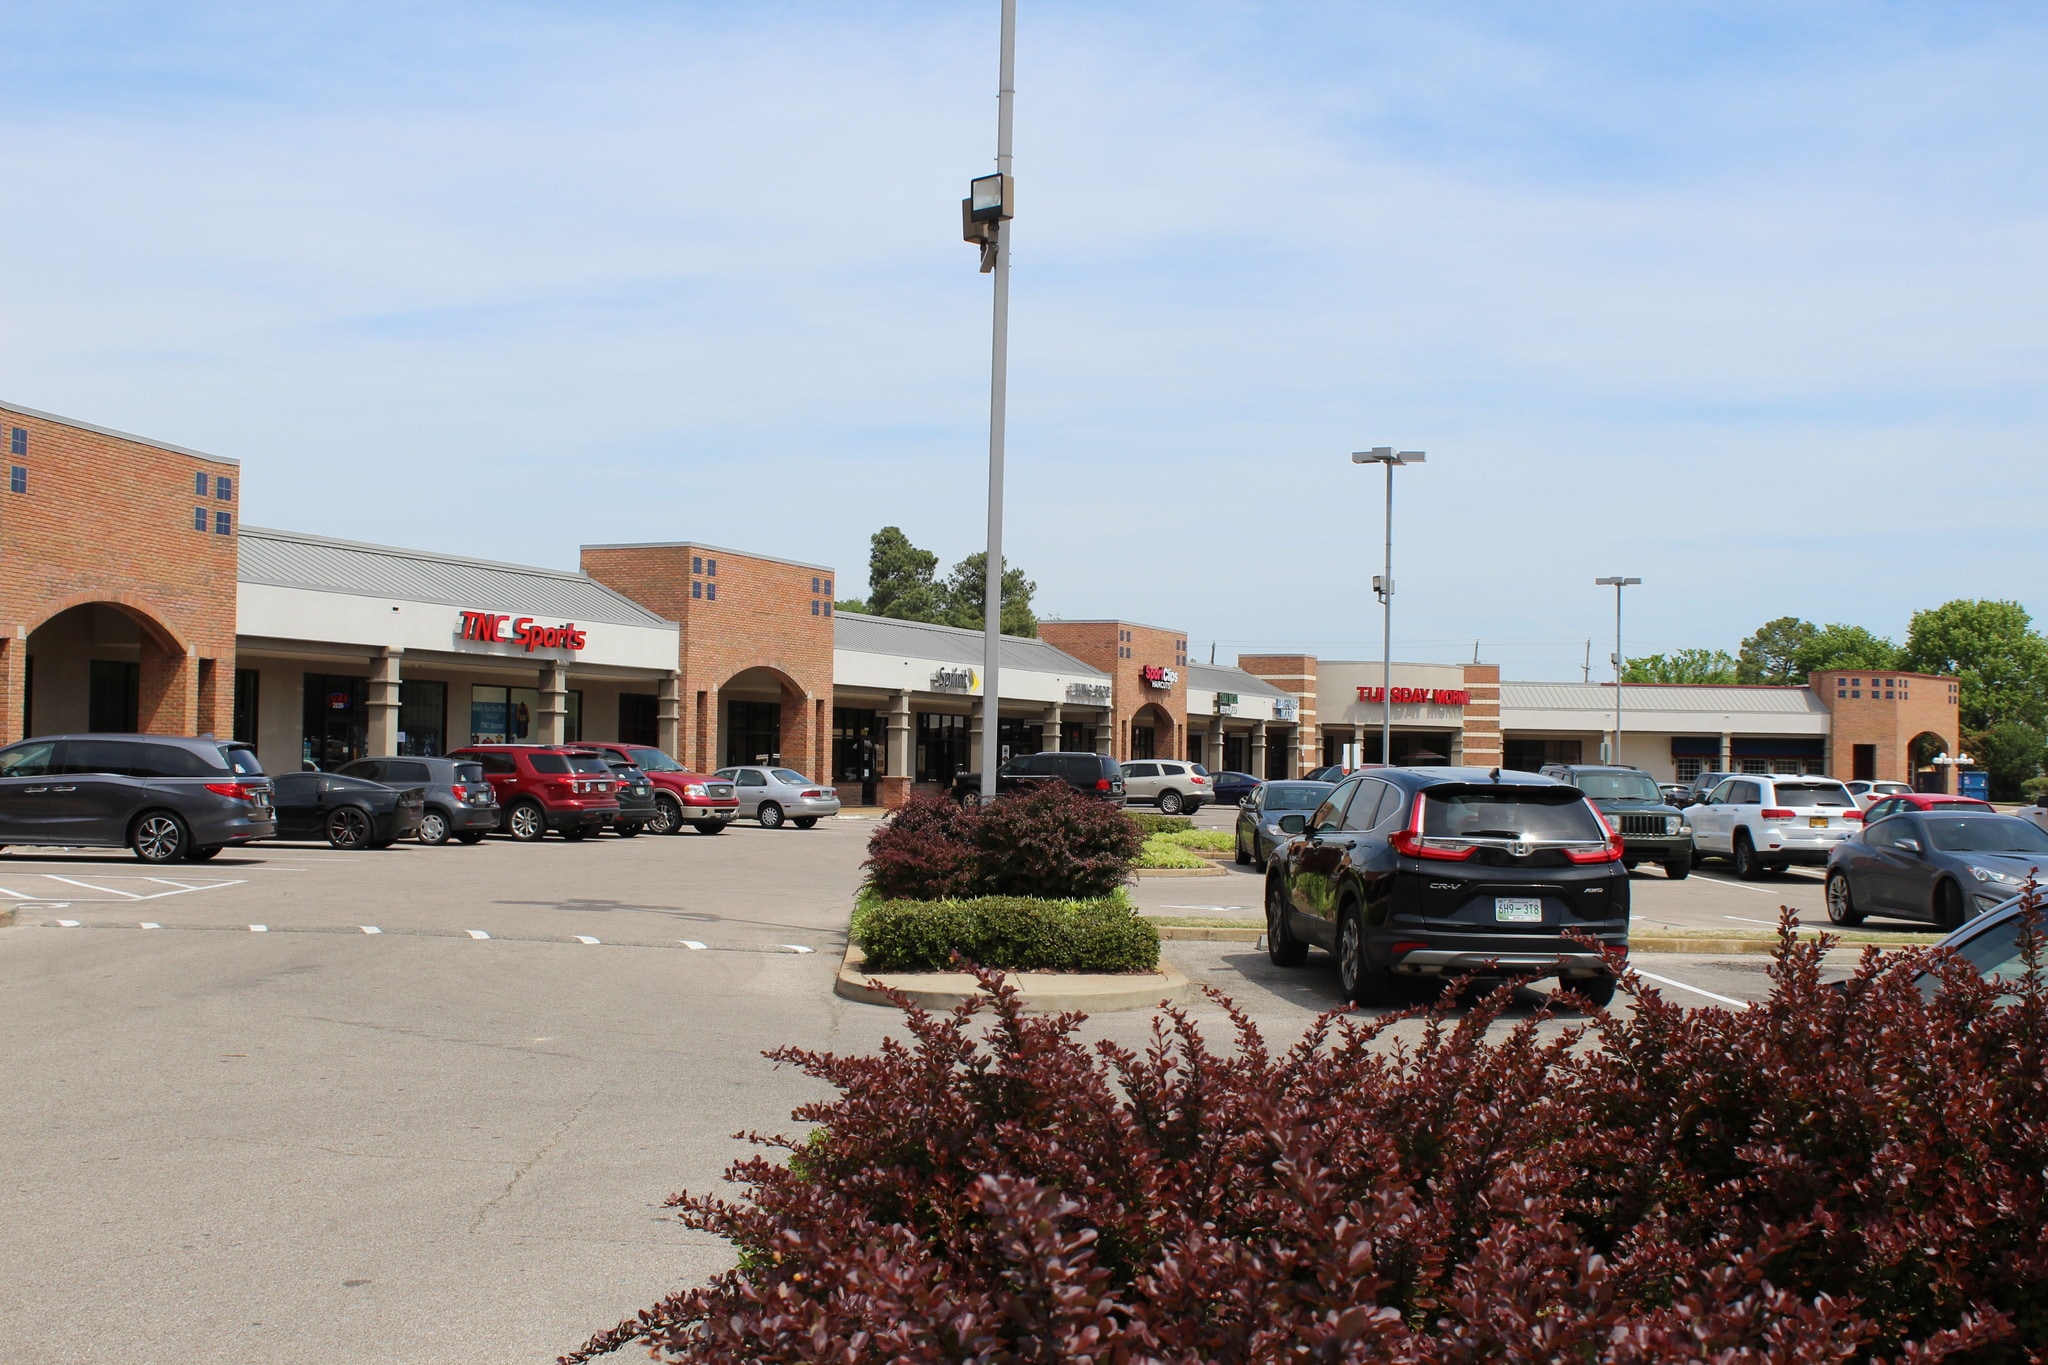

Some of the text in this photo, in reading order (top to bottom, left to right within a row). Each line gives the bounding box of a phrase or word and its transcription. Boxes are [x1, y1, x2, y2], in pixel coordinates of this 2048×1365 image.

[460, 610, 587, 652] TNC Sports
[938, 667, 968, 692] Sprint
[1429, 882, 1462, 890] CR-V
